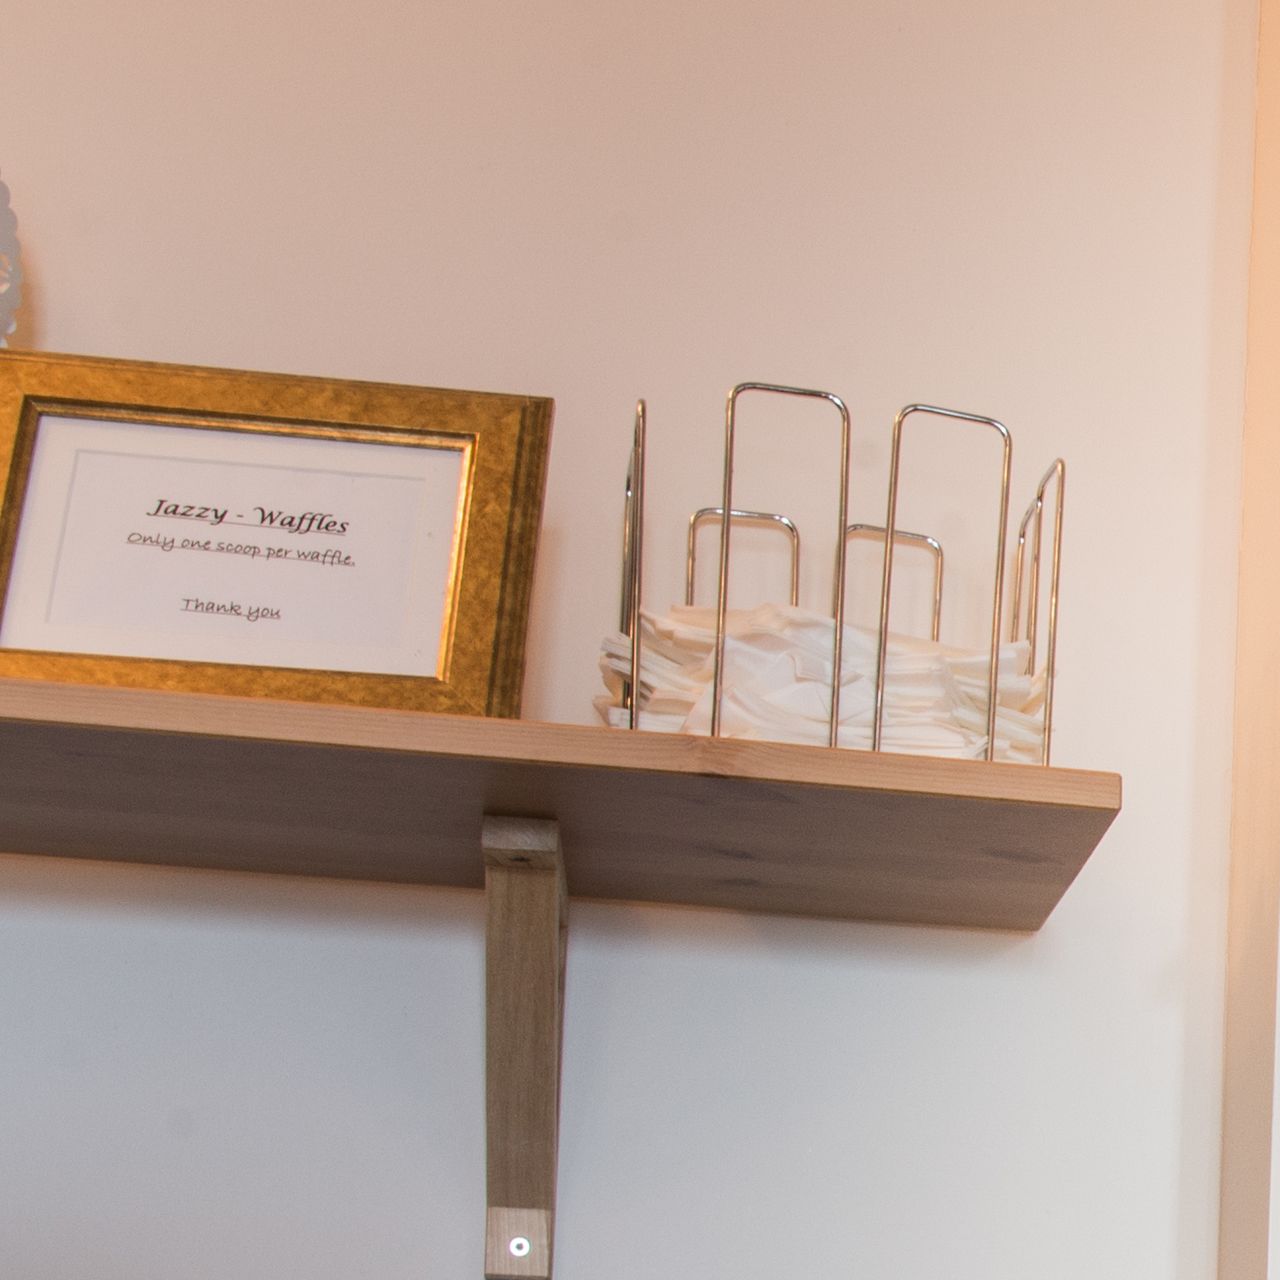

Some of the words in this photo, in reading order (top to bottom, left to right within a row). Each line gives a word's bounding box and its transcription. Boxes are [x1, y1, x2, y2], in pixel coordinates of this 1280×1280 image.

[146, 499, 228, 525] Jazzy
[254, 507, 349, 534] Waffles
[127, 532, 175, 551] Only
[181, 538, 211, 550] one
[216, 542, 261, 558] scoop
[266, 547, 290, 560] per
[297, 549, 355, 566] waffle.
[182, 598, 241, 616] Thank
[248, 606, 280, 622] you
